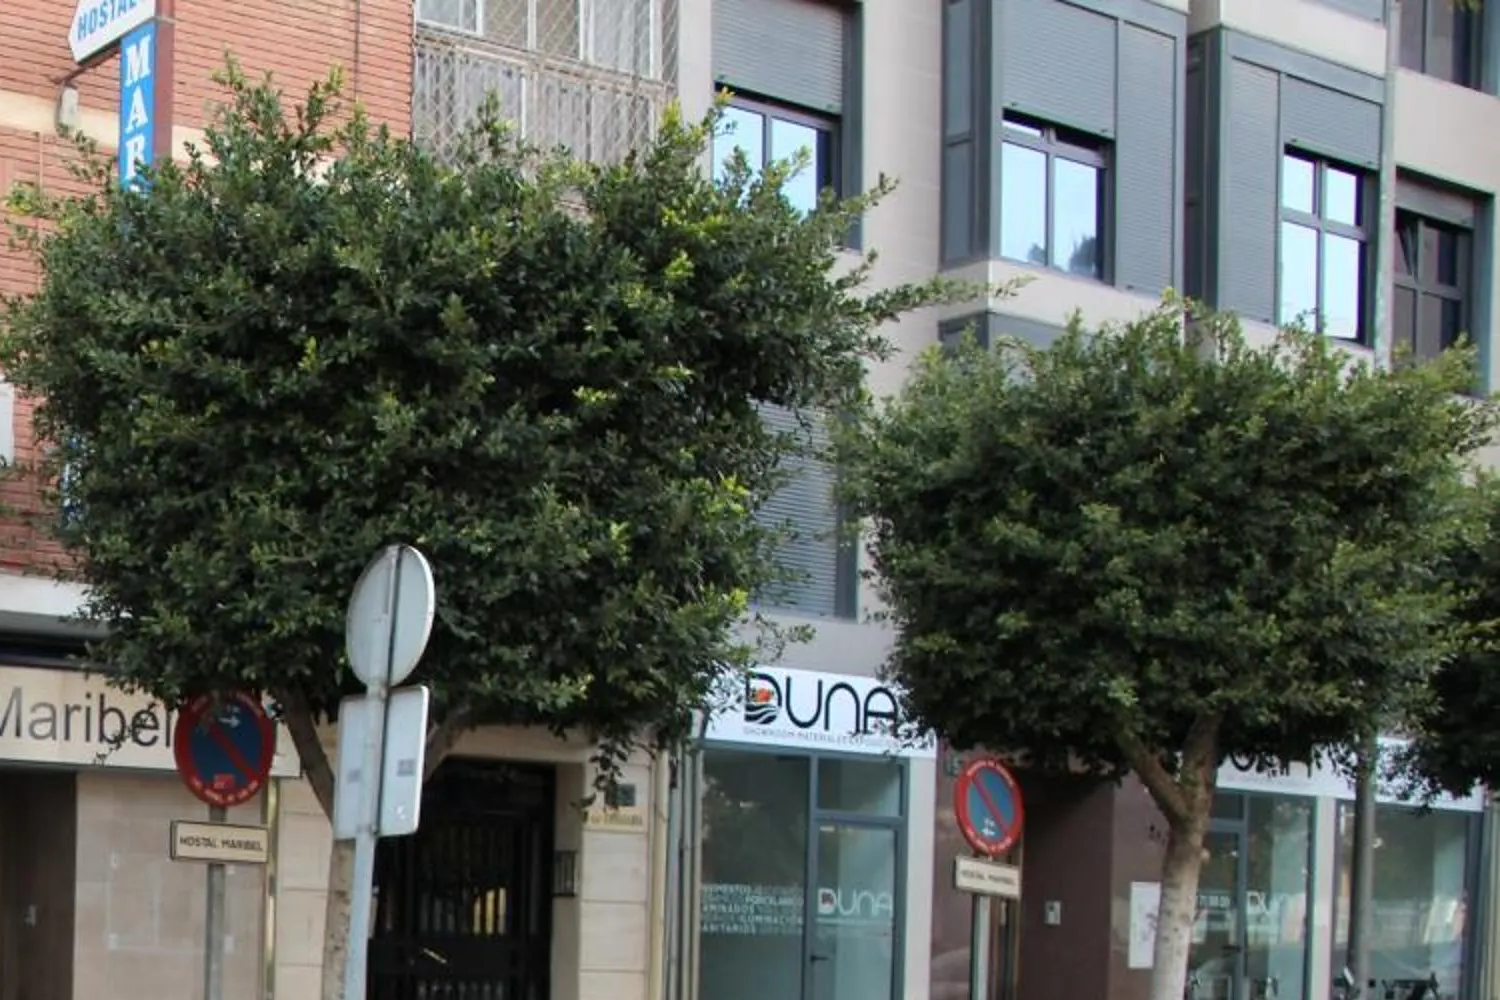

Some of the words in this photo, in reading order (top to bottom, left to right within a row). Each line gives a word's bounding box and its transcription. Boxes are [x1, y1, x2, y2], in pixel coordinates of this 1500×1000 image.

[745, 671, 899, 738] DUNA
[179, 835, 217, 849] HOSTAL
[221, 839, 264, 851] MARIBEL
